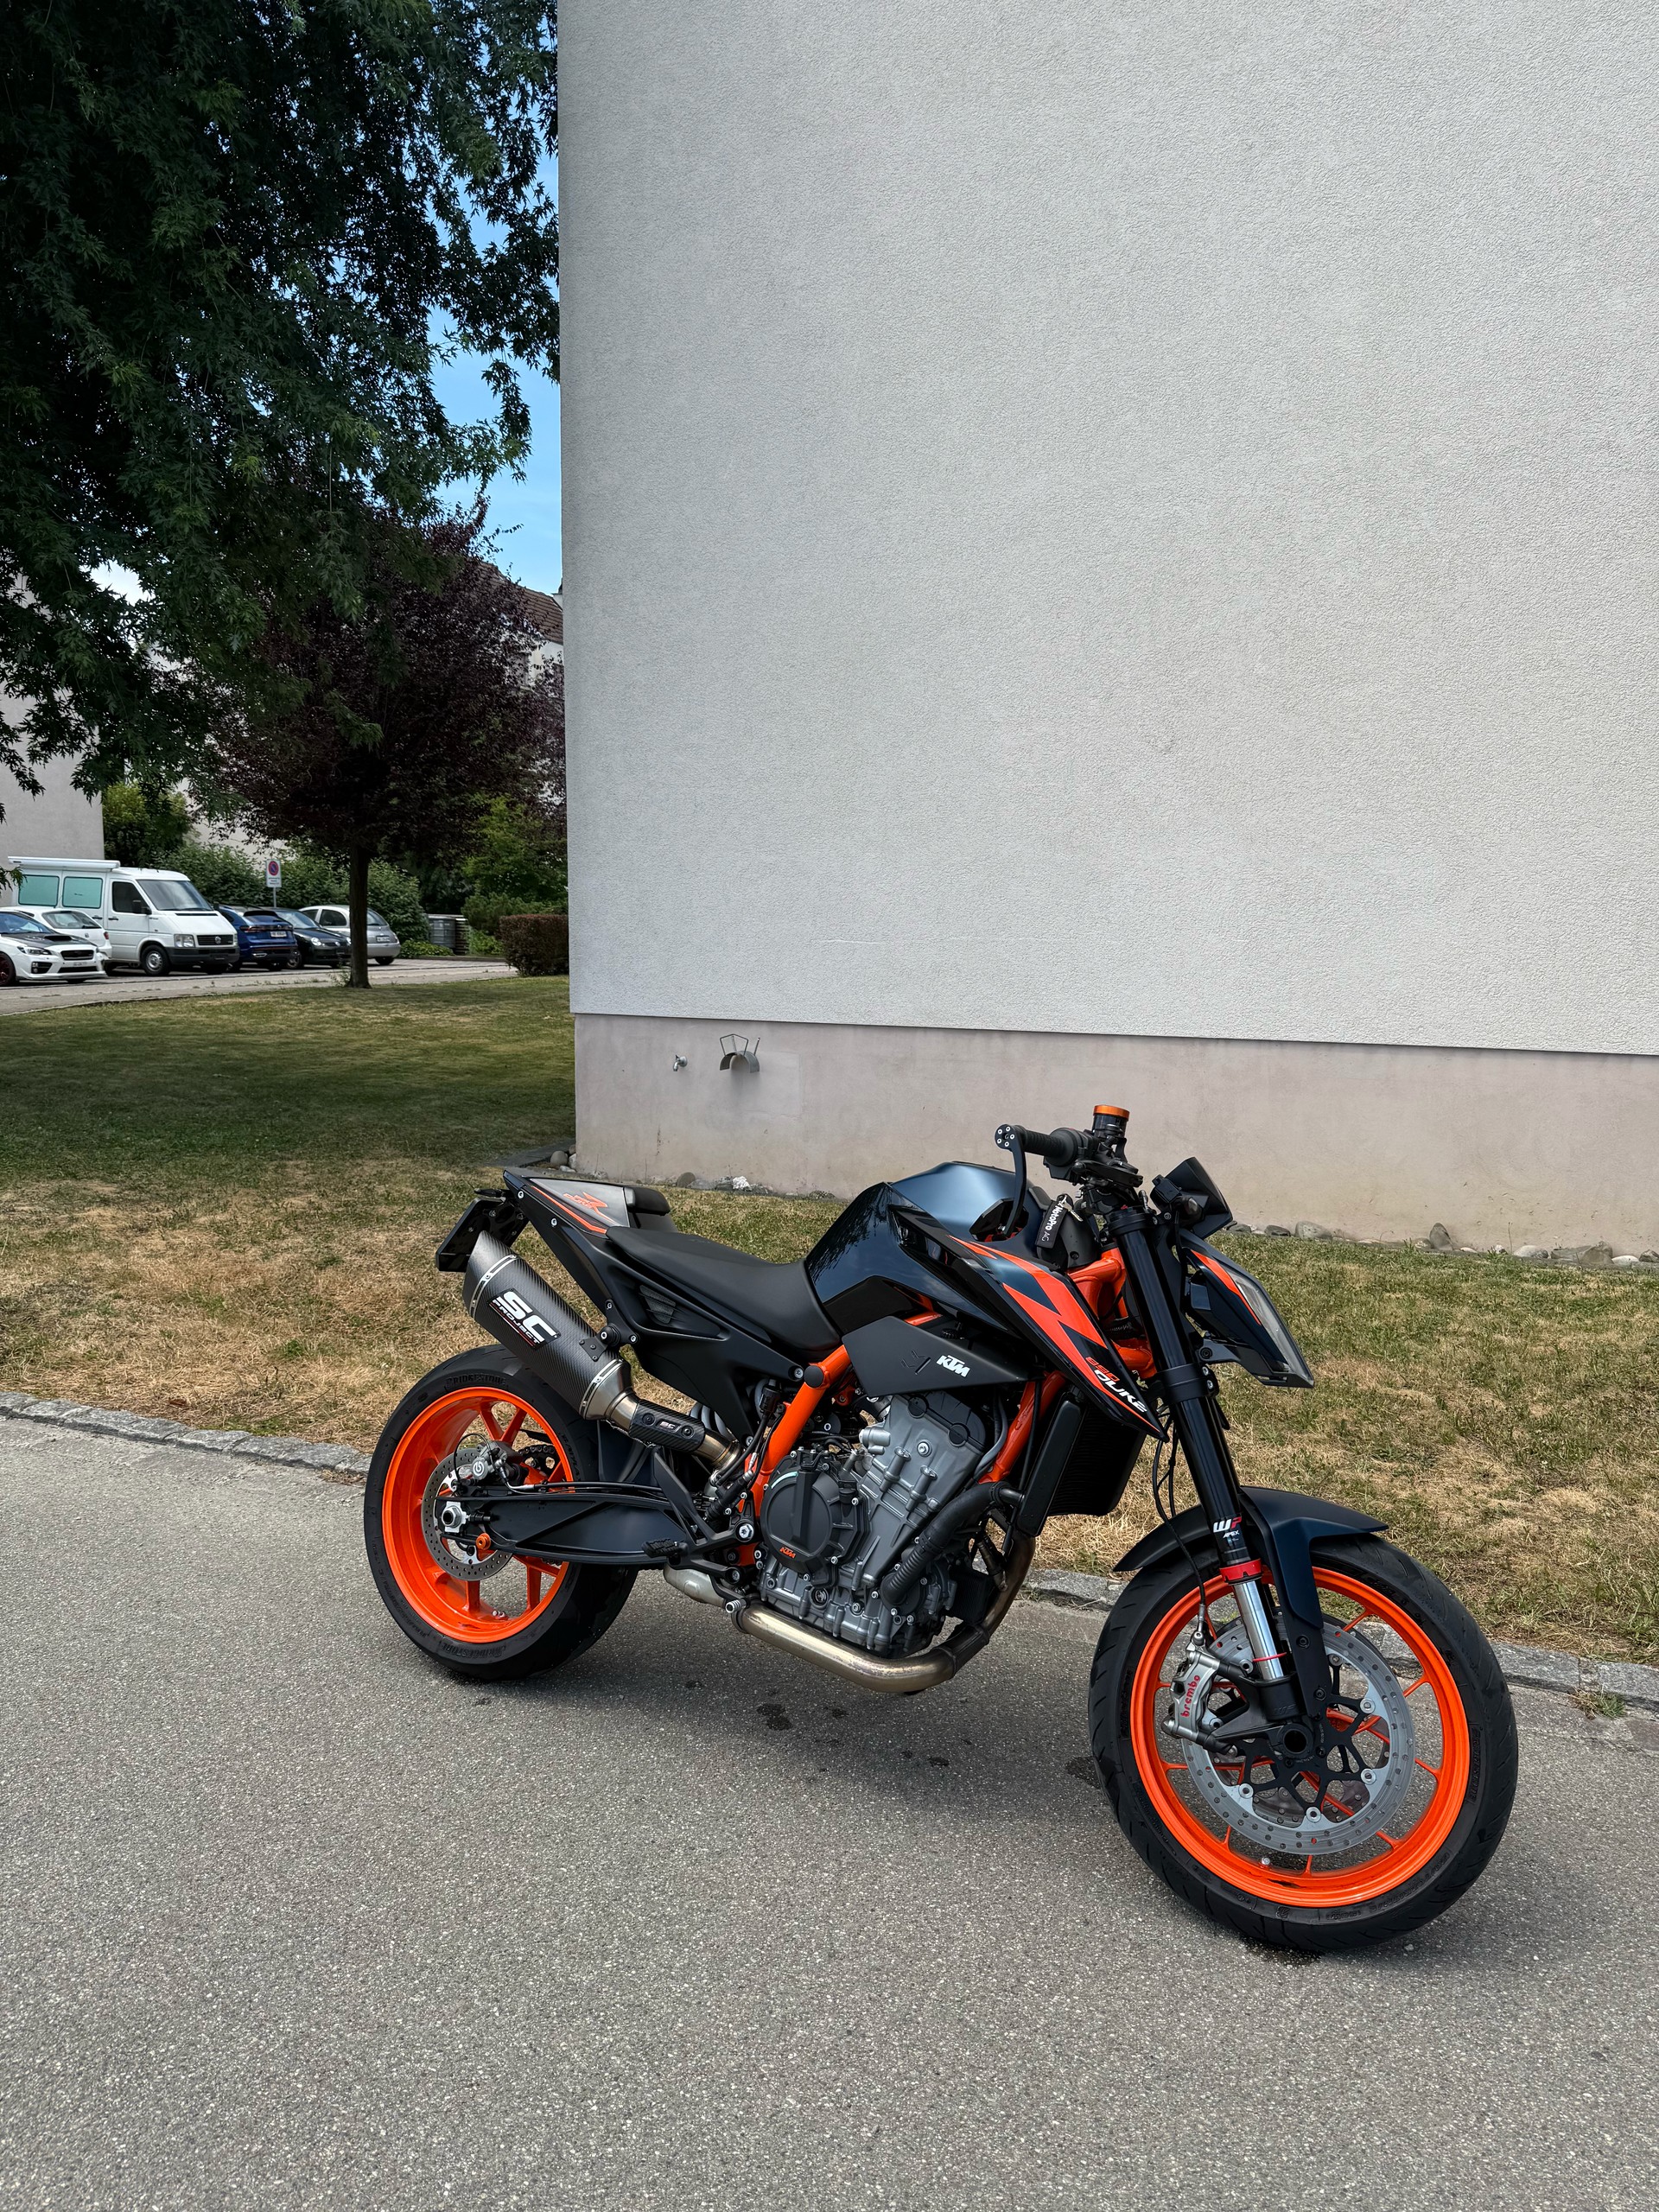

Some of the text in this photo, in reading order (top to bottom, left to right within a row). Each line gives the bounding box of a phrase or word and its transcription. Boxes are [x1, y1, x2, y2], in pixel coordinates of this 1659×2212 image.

[492, 1299, 540, 1344] PROJECT
[496, 1291, 557, 1343] SC
[936, 1355, 970, 1377] KTM
[1094, 1370, 1147, 1413] DUKE
[1213, 1516, 1242, 1533] WP
[779, 1547, 796, 1559] KTM
[1180, 1675, 1201, 1717] brembo
